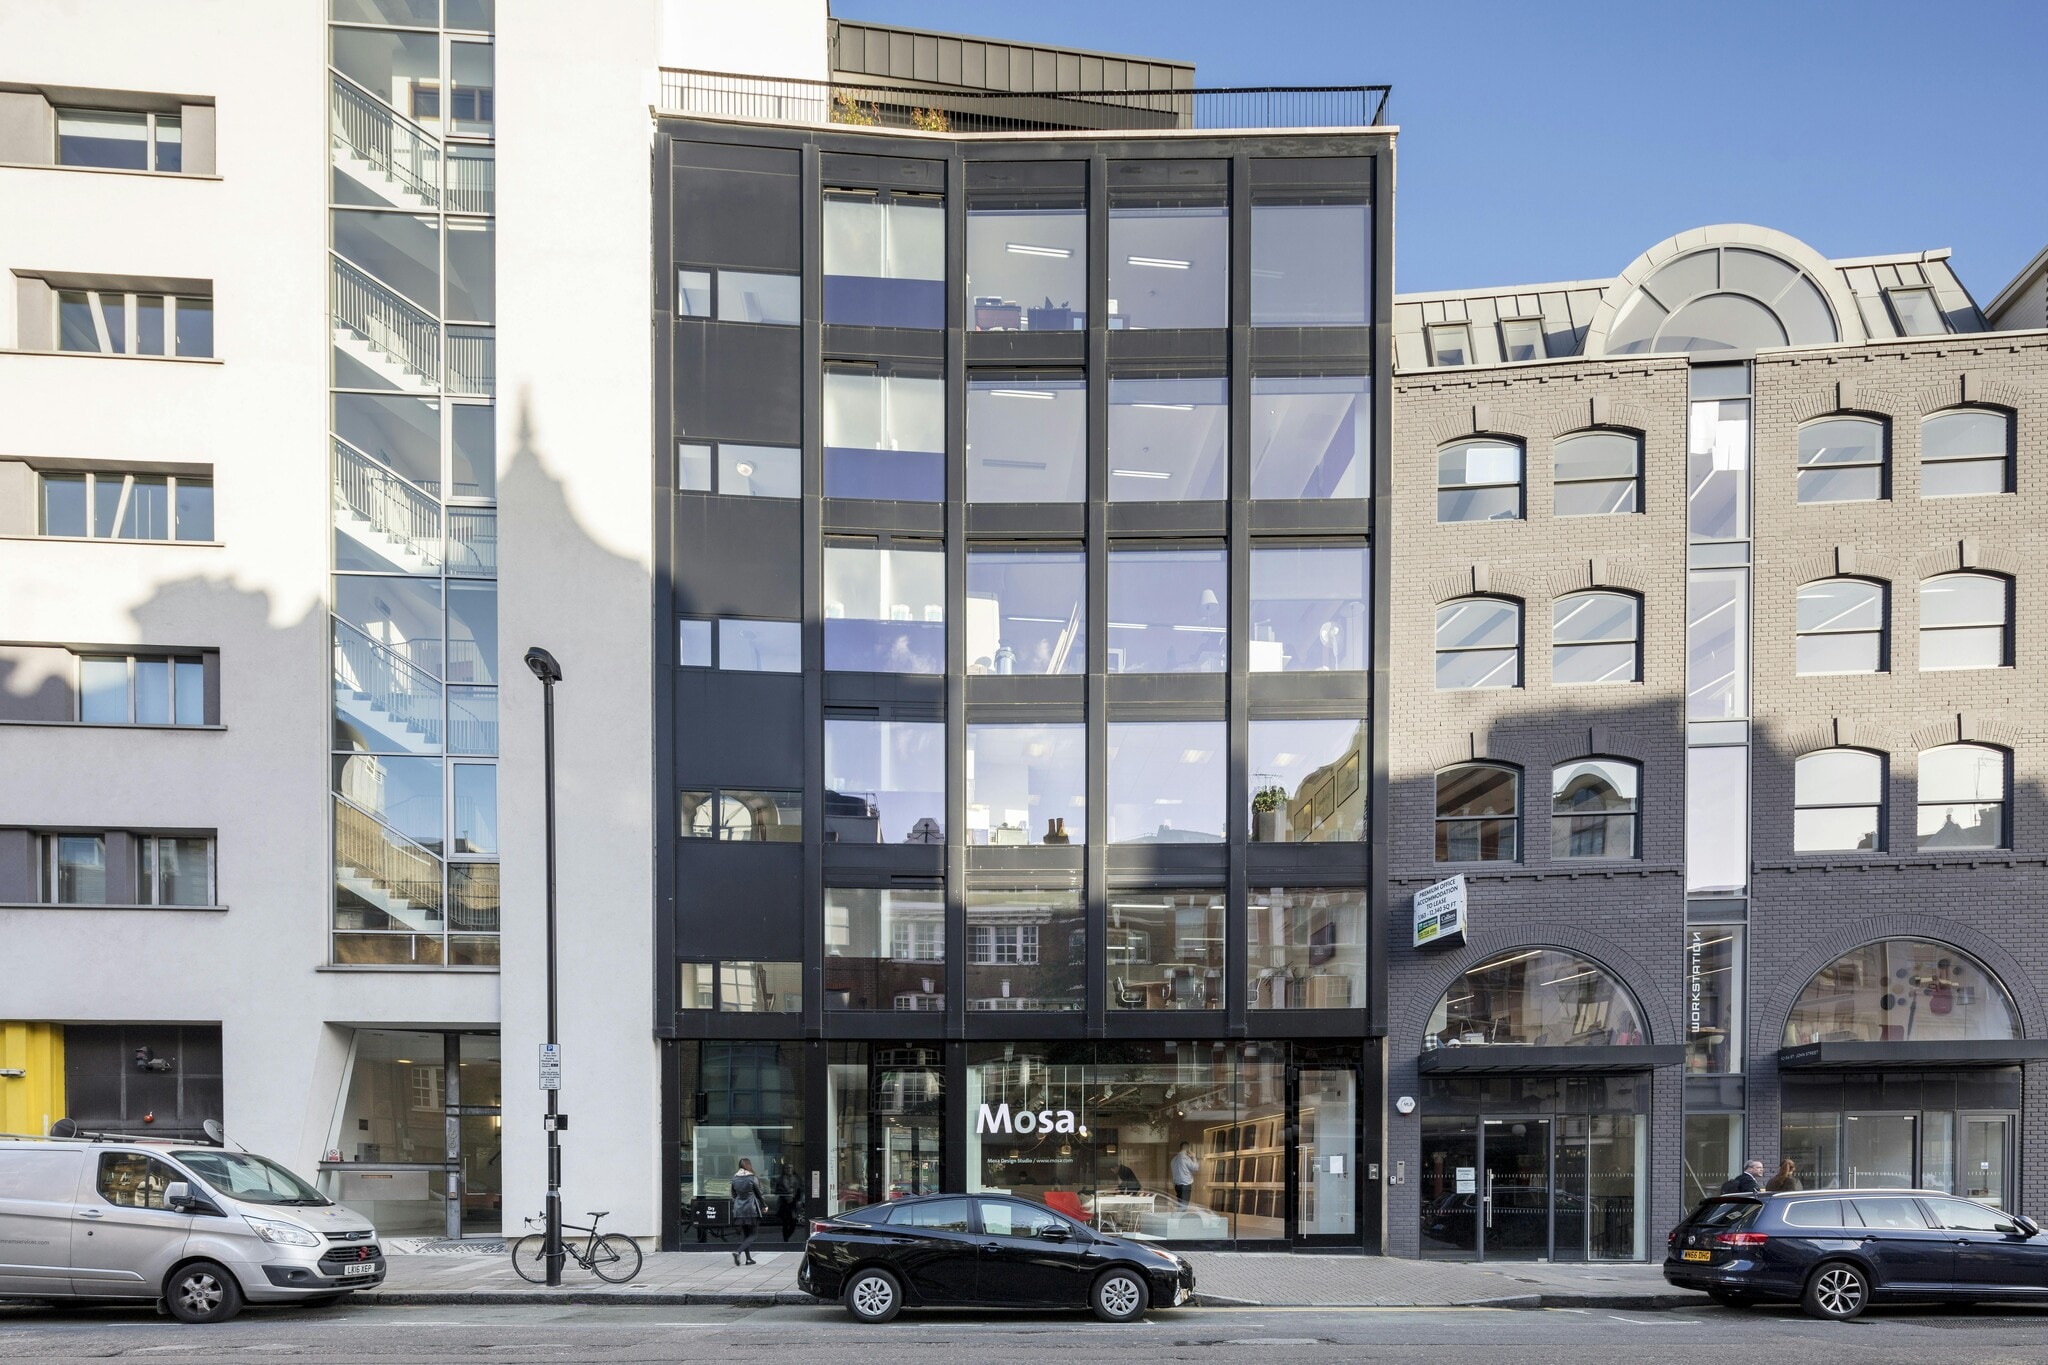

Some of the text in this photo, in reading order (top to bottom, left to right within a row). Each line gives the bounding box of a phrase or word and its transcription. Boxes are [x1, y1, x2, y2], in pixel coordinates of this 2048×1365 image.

[1419, 879, 1456, 897] PREMIUM OFFICE
[1417, 885, 1458, 907] ACCOMMODATION
[1433, 897, 1447, 906] LEASE
[1443, 903, 1450, 911] SQ
[1691, 932, 1701, 1033] WORKSTATION
[976, 1103, 1087, 1134] Mosa.
[1698, 1251, 1709, 1259] DHG
[347, 1265, 372, 1274] LK16 XEP
